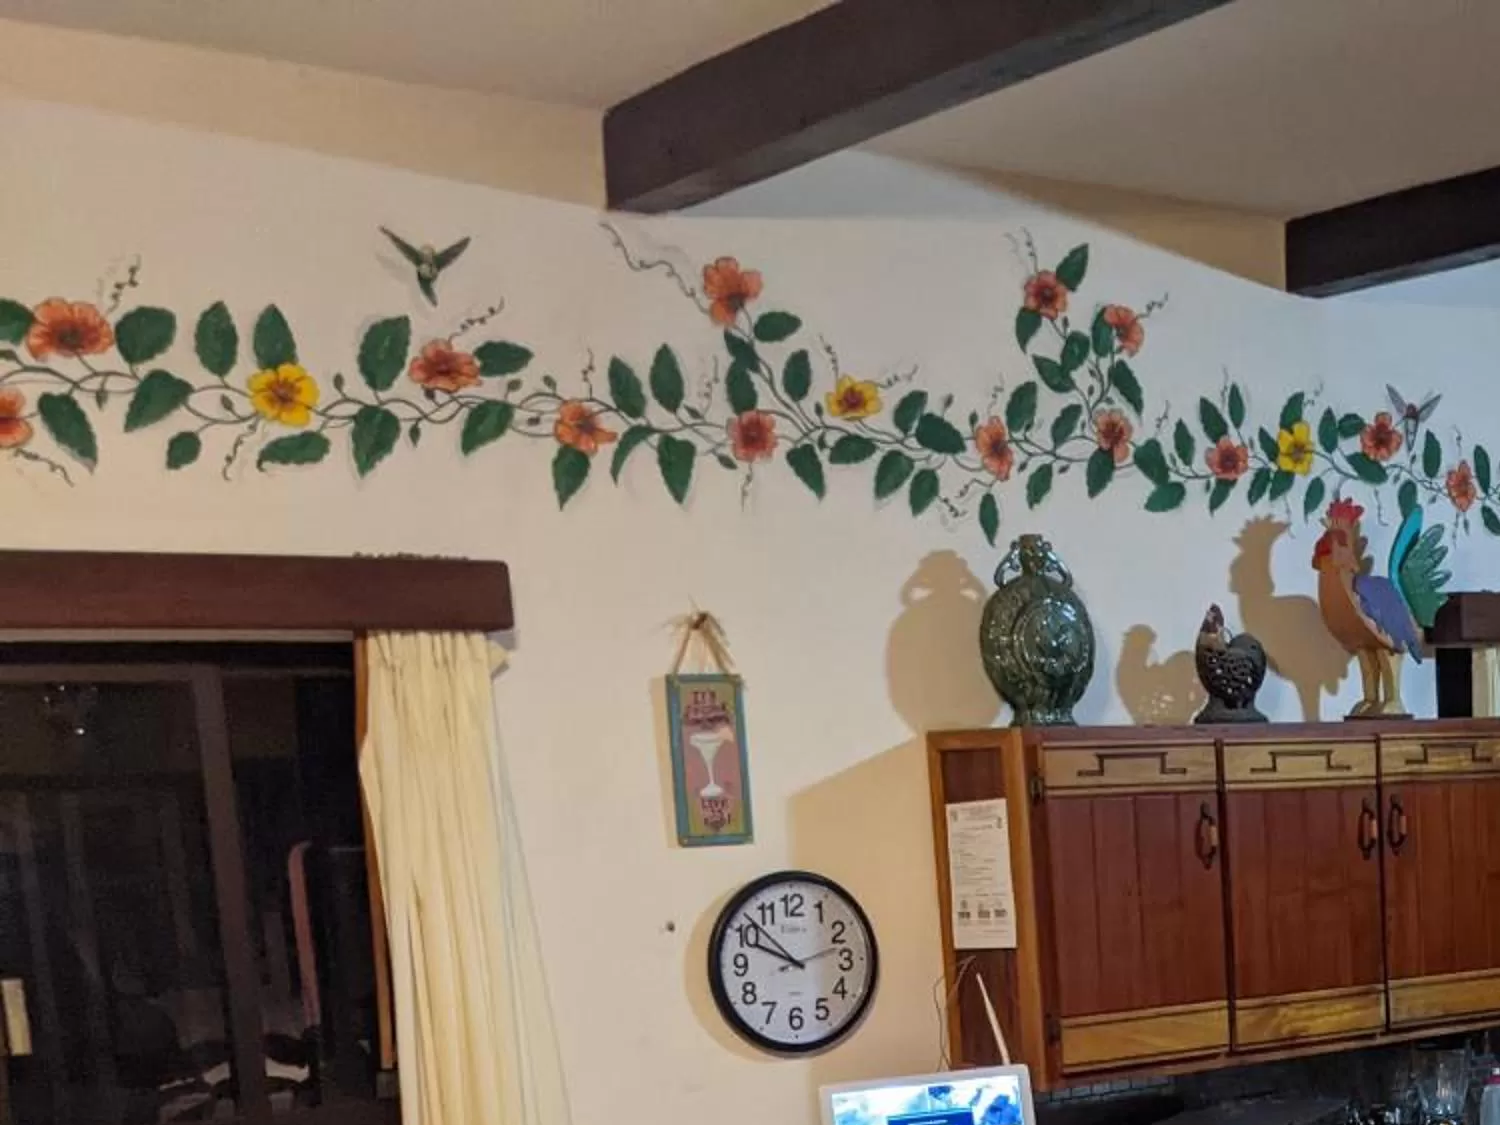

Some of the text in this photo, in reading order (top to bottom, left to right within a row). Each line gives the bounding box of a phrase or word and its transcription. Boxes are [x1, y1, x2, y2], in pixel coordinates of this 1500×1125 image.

[757, 902, 776, 926] 11
[780, 893, 805, 917] 12
[813, 901, 824, 924] 1
[735, 923, 760, 948] 10
[831, 920, 847, 944] 2
[733, 953, 749, 977] 9
[838, 948, 854, 971] 3
[741, 981, 757, 1005] 8
[832, 976, 848, 999] 4
[761, 1001, 777, 1025] 7
[788, 1007, 804, 1031] 6
[815, 998, 830, 1021] 5
